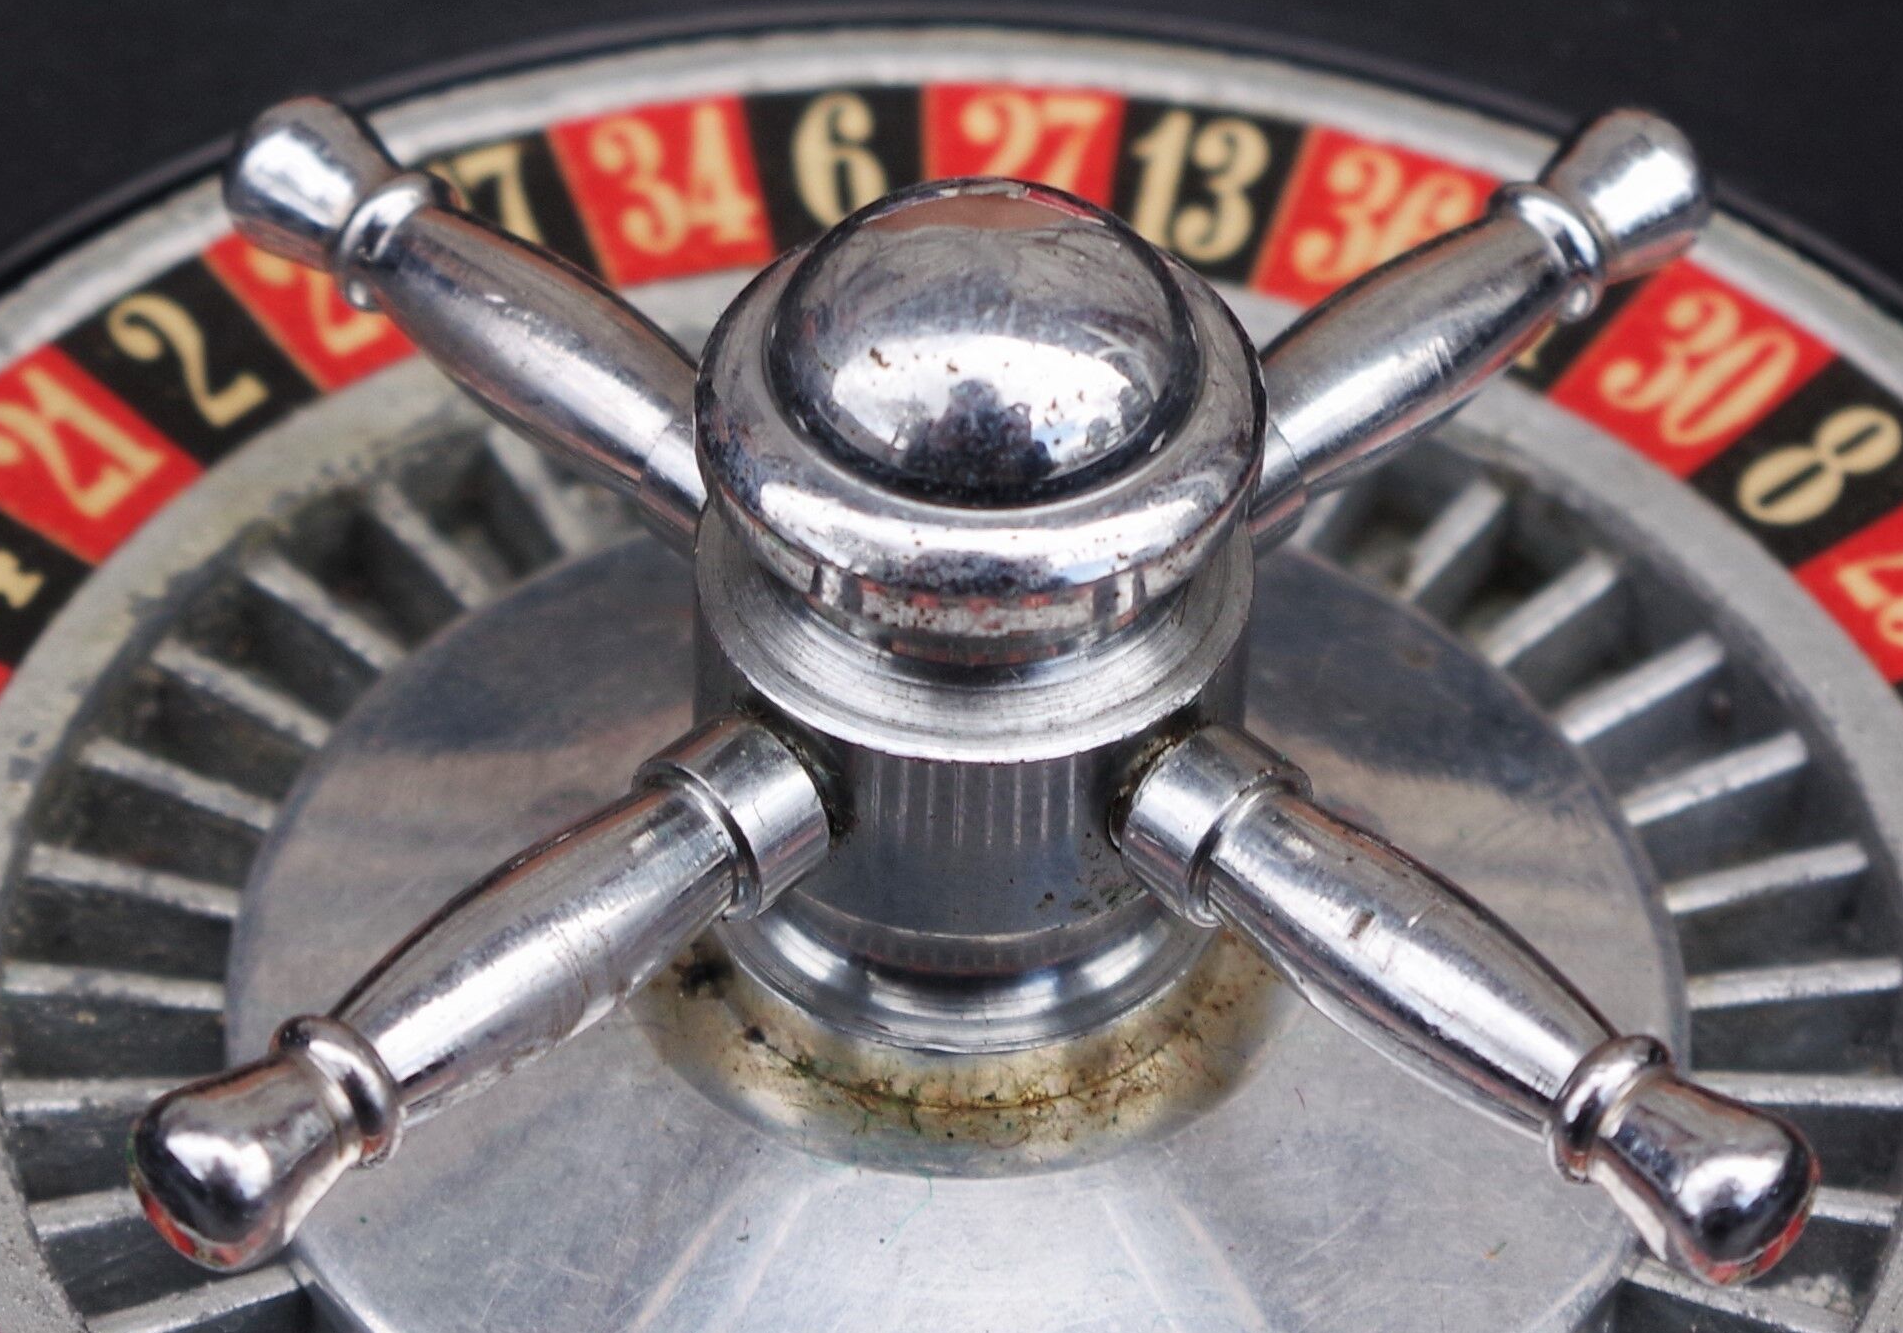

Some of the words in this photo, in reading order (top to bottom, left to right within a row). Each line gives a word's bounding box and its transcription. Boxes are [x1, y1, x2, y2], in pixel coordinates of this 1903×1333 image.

[428, 142, 544, 245] 7
[589, 104, 758, 255] 34
[792, 93, 881, 227] 6
[1130, 109, 1270, 263] 13
[109, 295, 268, 426] 2
[1599, 278, 1800, 447] 30
[1738, 407, 1902, 527] 8
